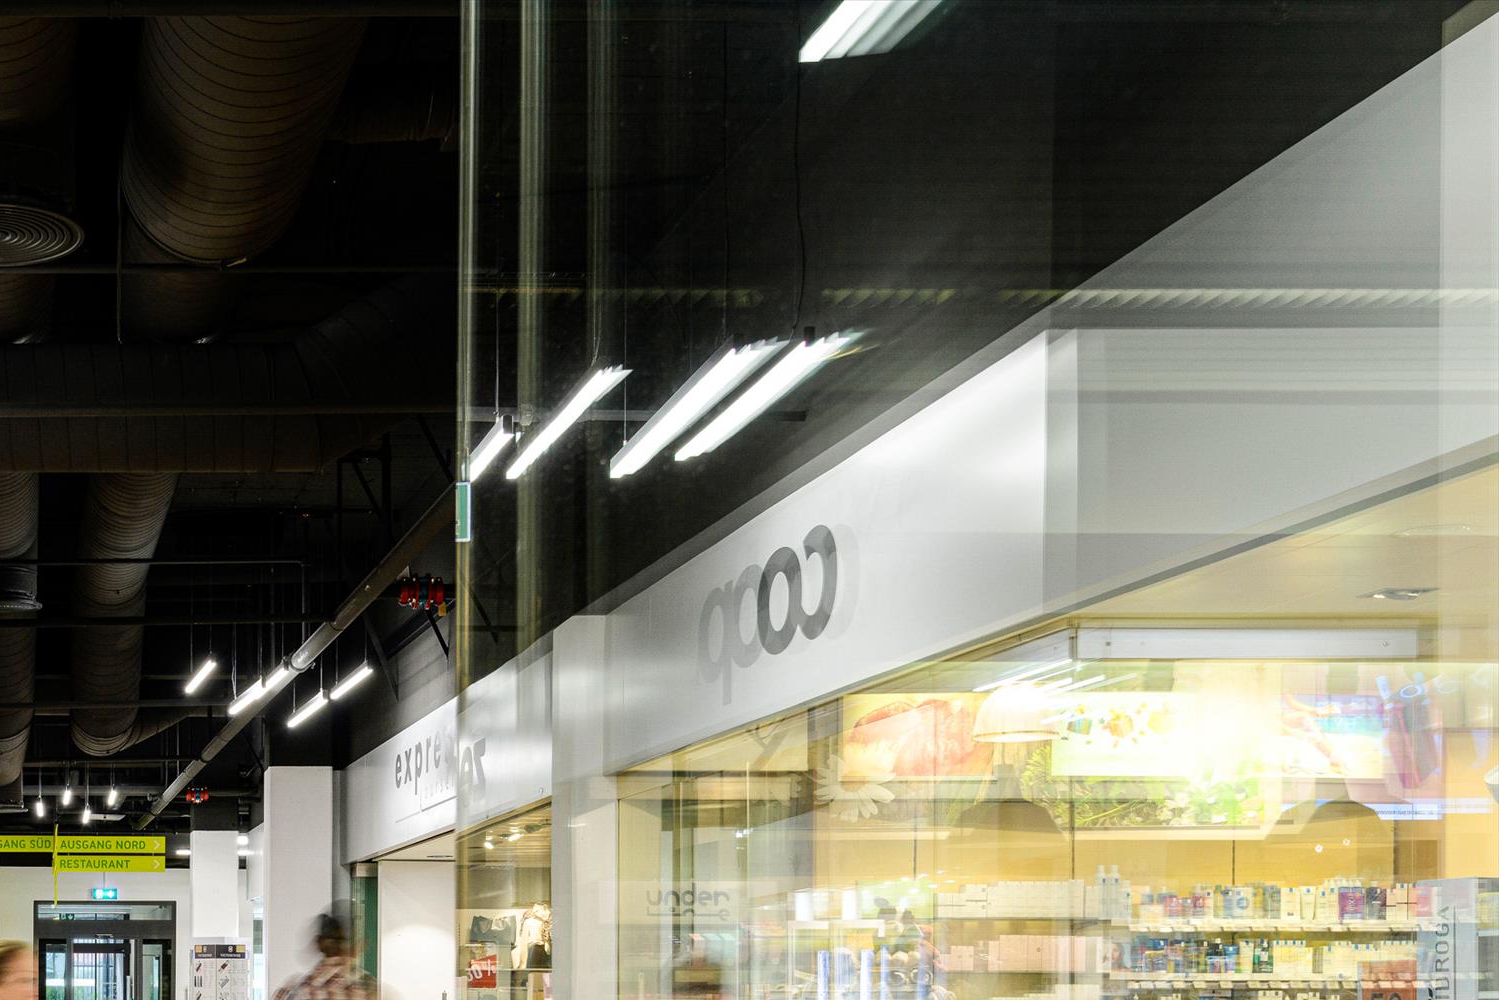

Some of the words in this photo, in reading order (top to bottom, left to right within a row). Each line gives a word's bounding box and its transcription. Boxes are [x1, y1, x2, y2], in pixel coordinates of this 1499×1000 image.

[30, 837, 51, 850] SÜD
[60, 840, 112, 850] AUSGANG
[115, 840, 146, 850] NORD
[59, 859, 131, 869] RESTAURANT
